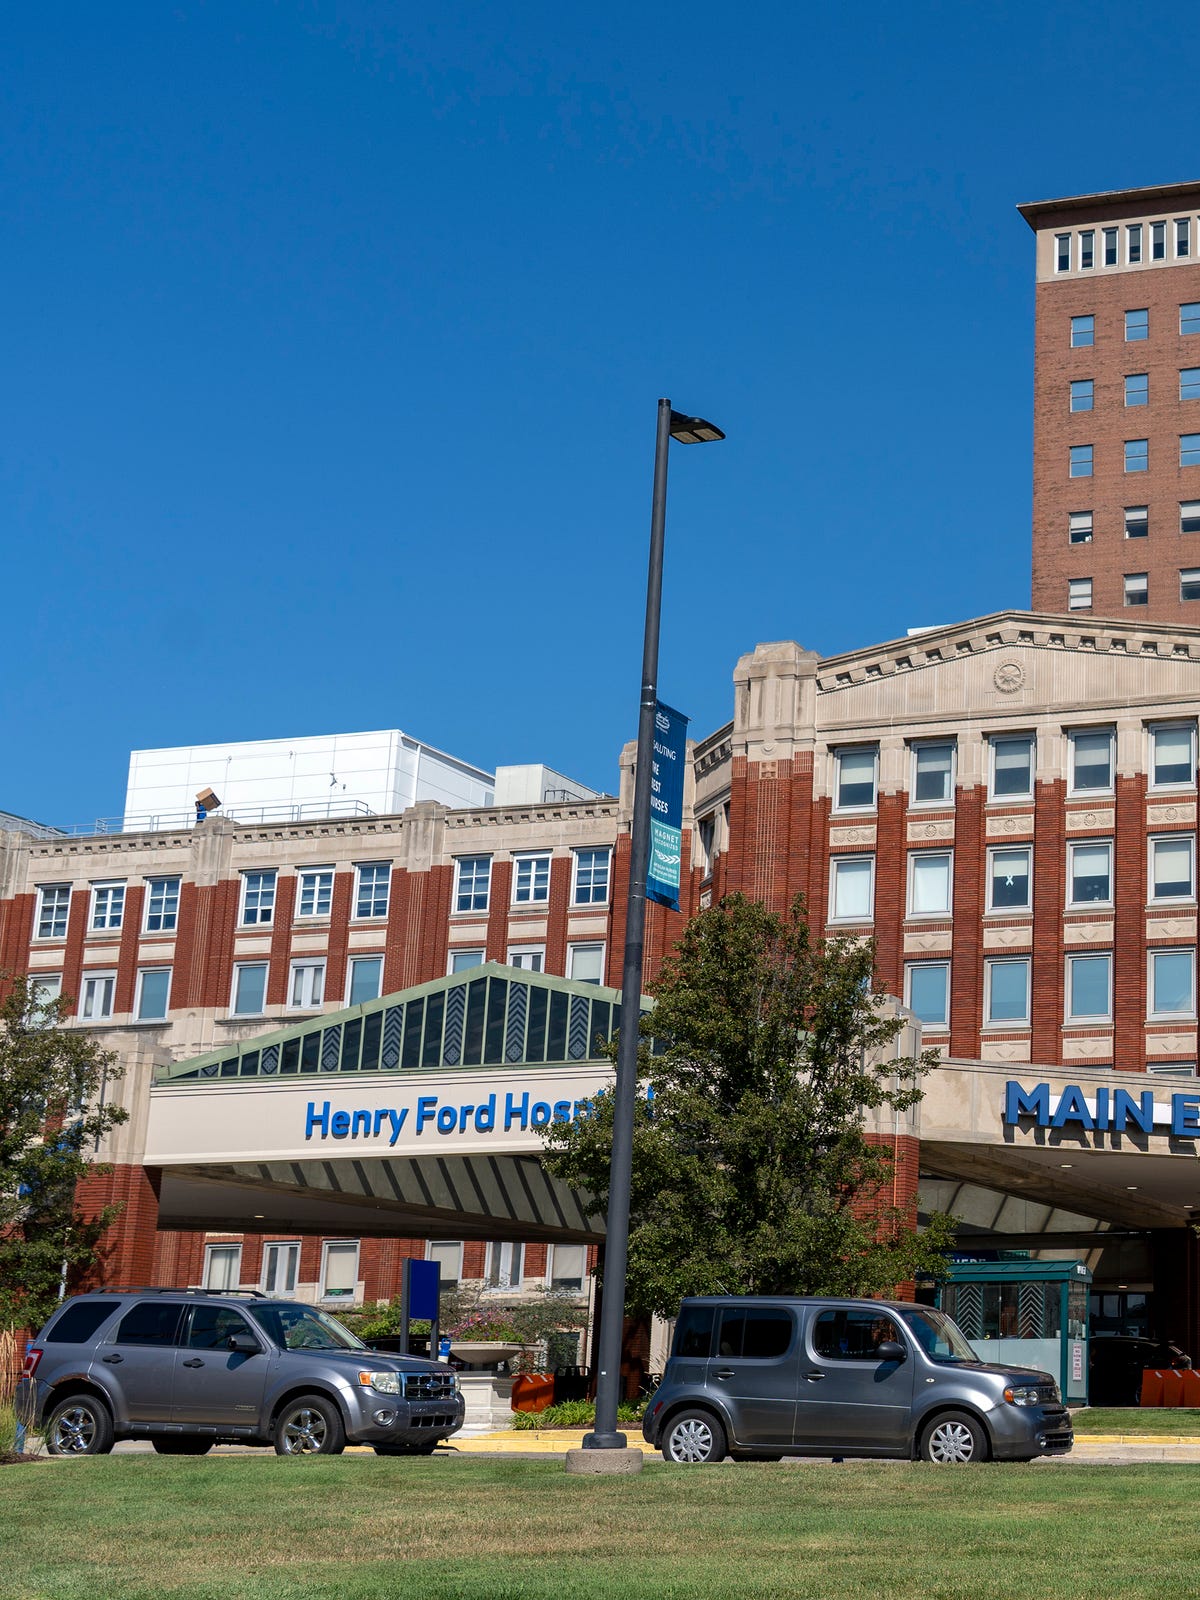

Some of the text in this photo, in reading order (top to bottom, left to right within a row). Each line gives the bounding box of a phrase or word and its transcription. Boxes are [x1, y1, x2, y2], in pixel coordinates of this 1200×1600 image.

[654, 828, 679, 844] MAGNET
[305, 1101, 409, 1146] Henry
[416, 1094, 496, 1136] Ford
[1005, 1080, 1153, 1133] MAIN
